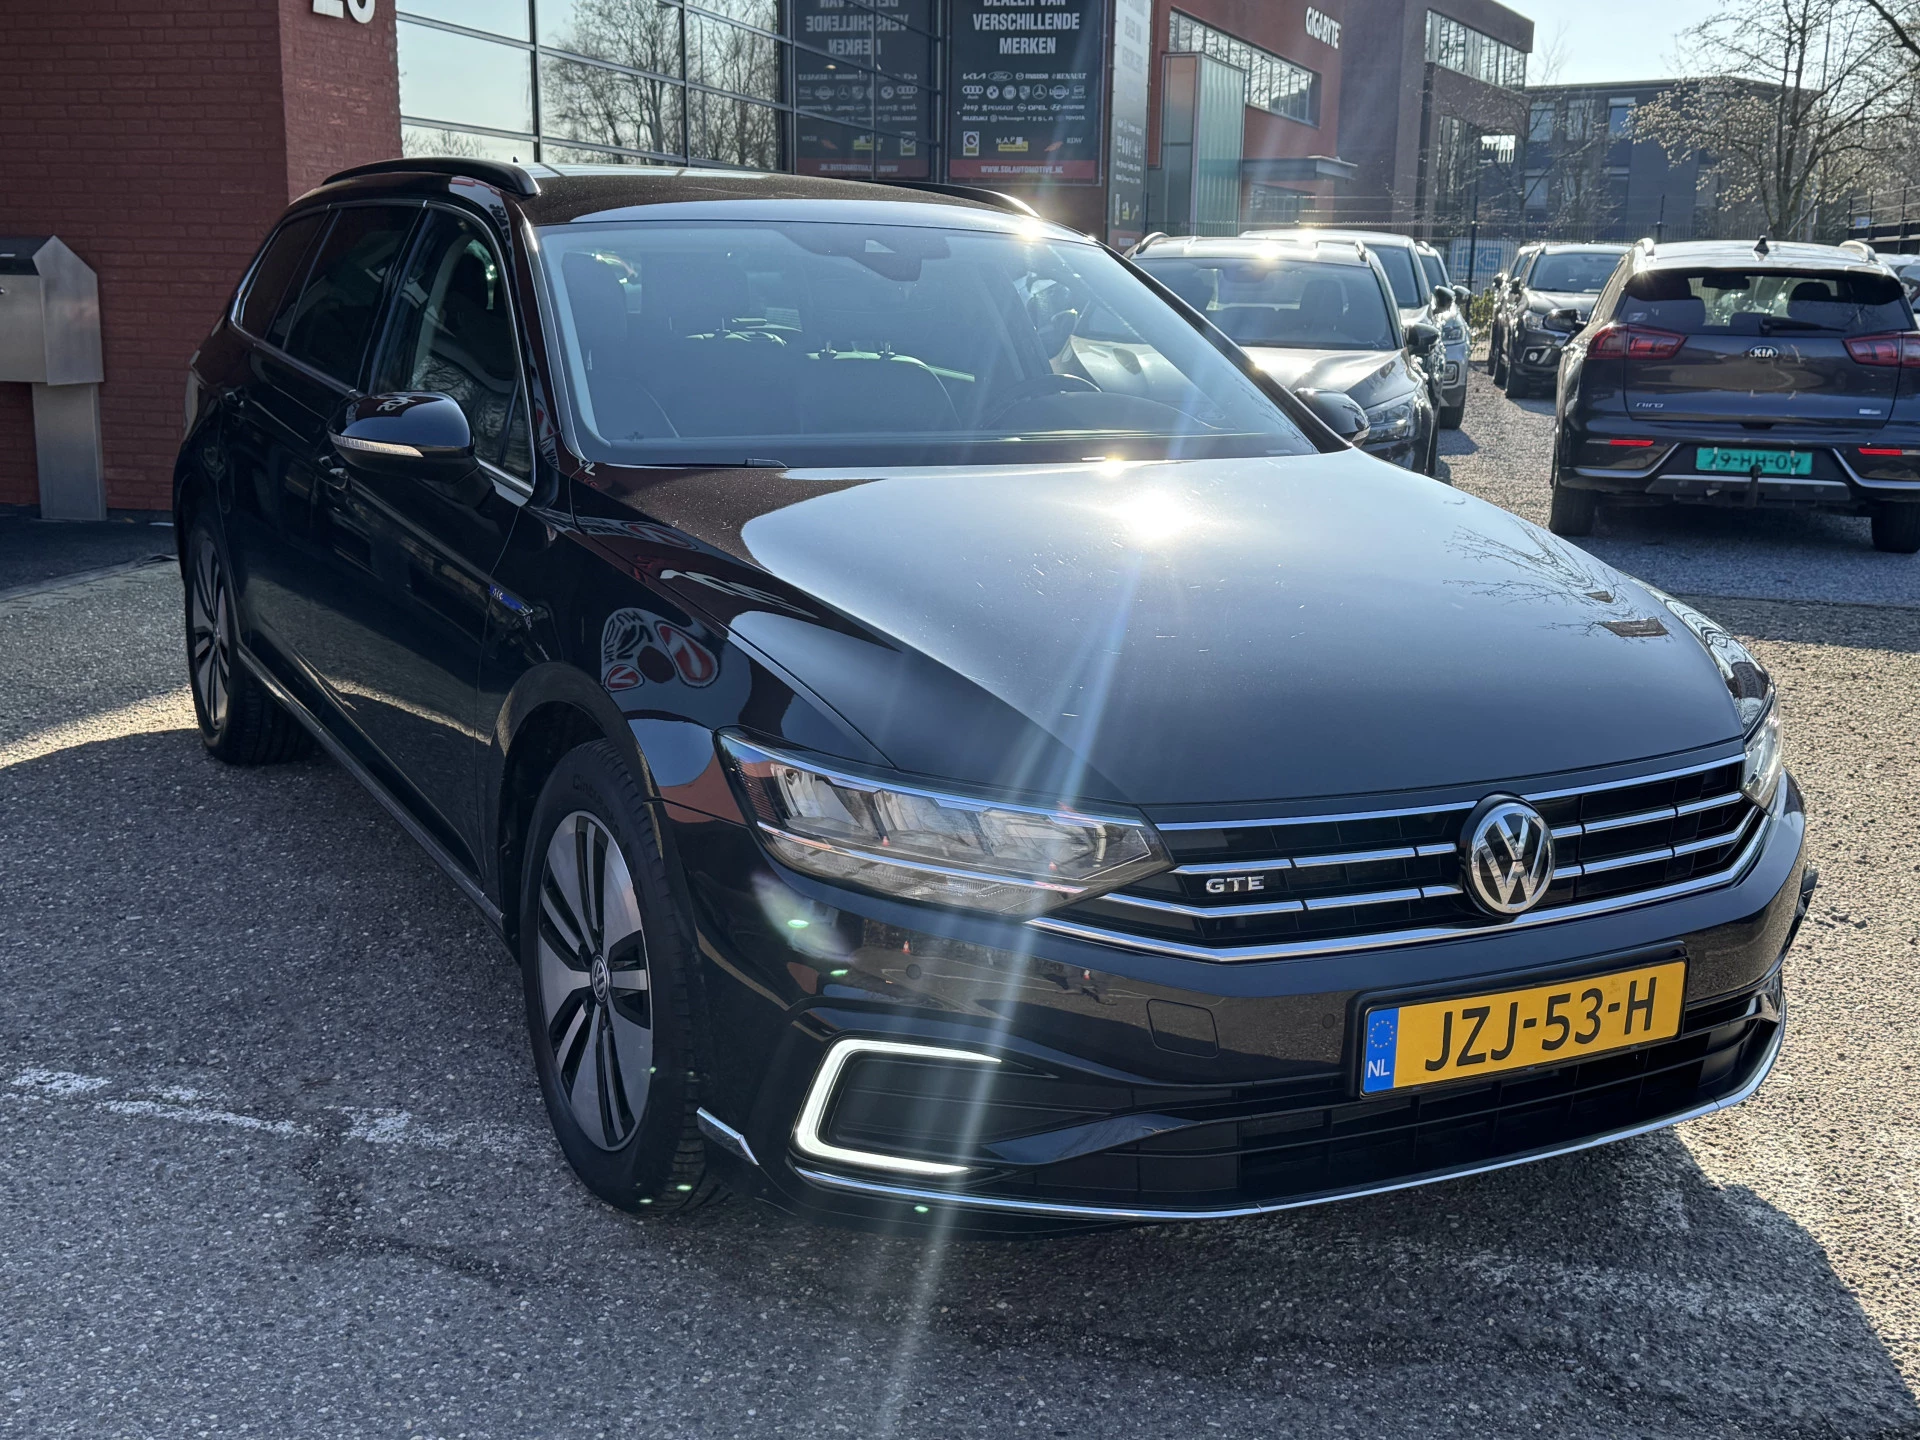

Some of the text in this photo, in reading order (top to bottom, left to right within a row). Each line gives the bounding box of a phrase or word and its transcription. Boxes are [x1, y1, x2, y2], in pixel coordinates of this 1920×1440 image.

[973, 13, 1080, 30] VERSCHILLENDE
[1306, 6, 1341, 49] GIGABYTE
[999, 37, 1056, 54] MERKEN
[1753, 347, 1774, 358] KIA
[1205, 876, 1265, 893] GTE
[1425, 977, 1657, 1071] JZJ-53-H
[1367, 1058, 1390, 1079] NL
